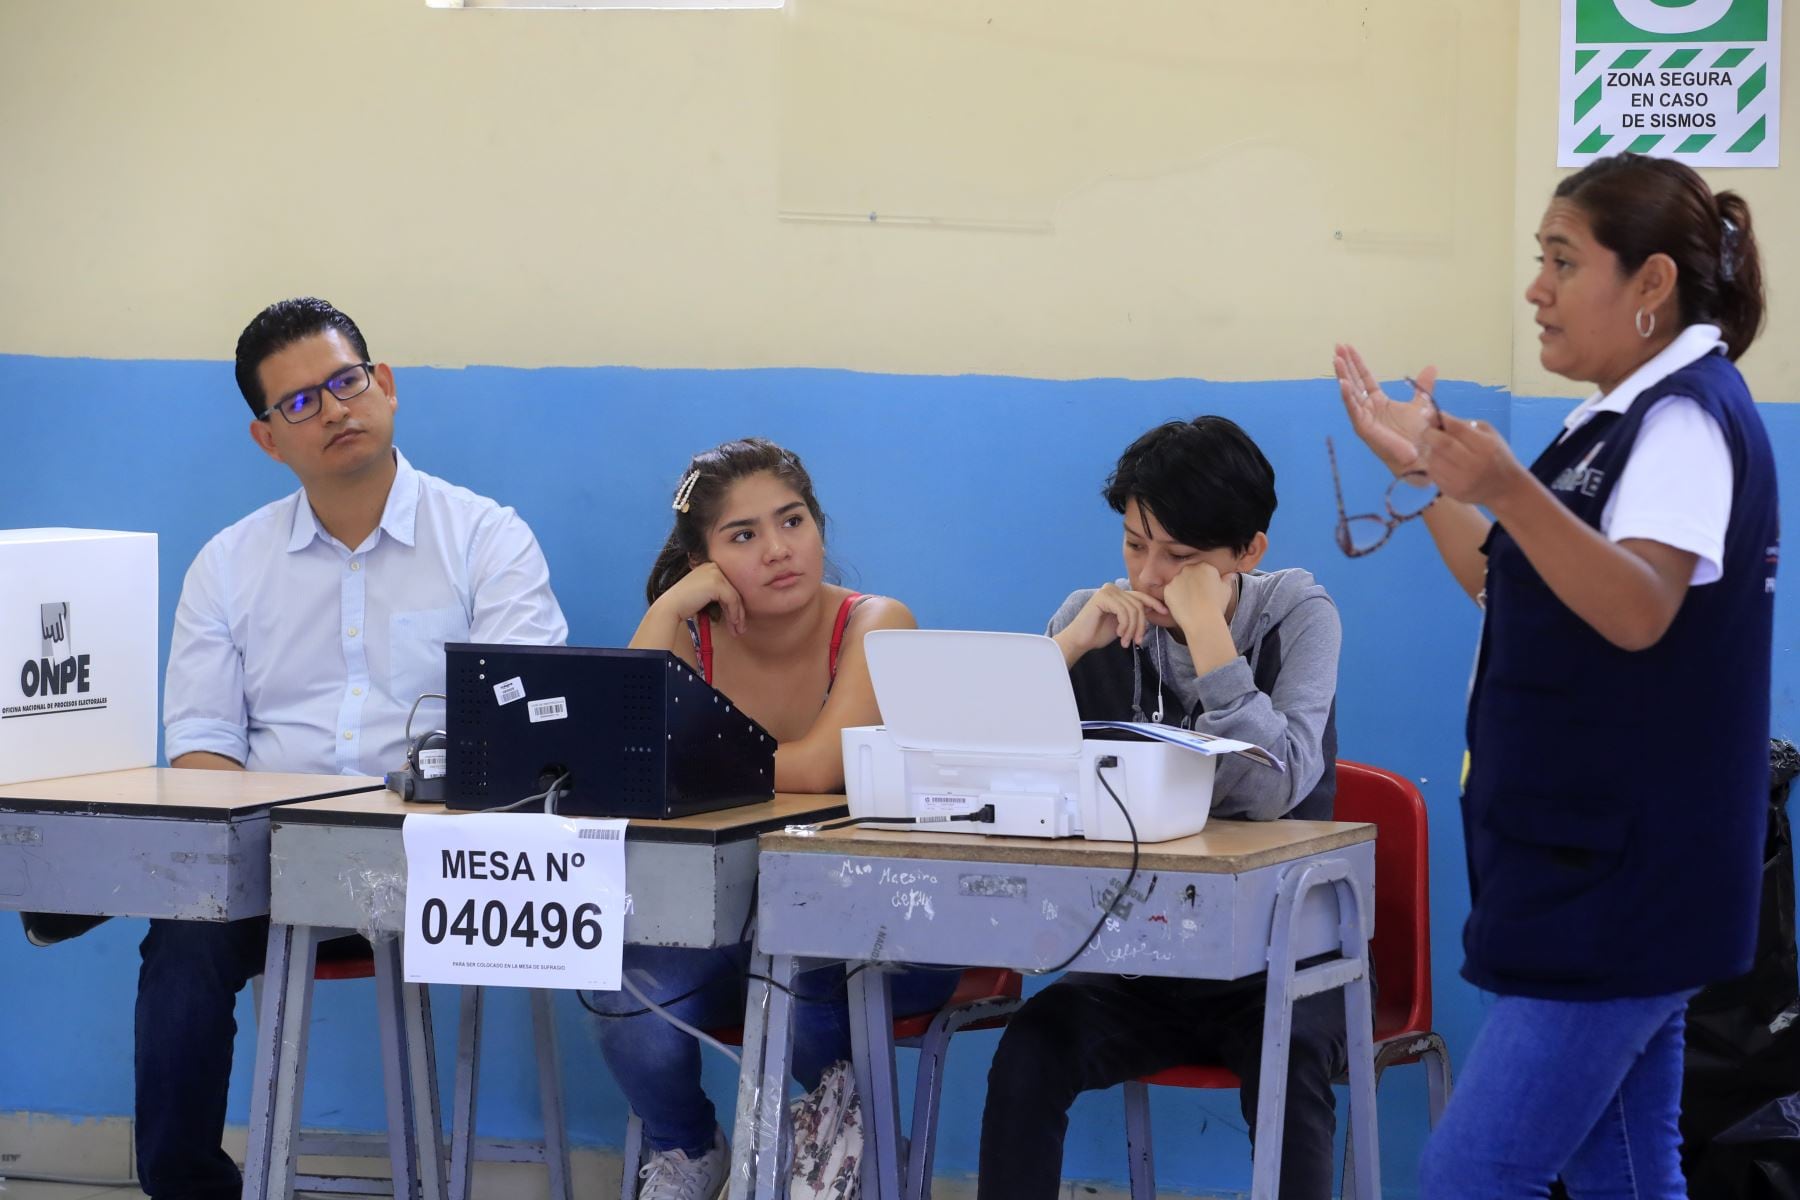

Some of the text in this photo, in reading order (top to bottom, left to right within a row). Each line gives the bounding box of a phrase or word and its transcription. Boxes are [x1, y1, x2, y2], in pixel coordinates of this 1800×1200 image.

[1606, 71, 1733, 87] ZONA SEGURA
[1631, 92, 1708, 107] EN CASO
[1622, 113, 1716, 128] DE SISMOS
[21, 654, 91, 698] ONPE
[2, 706, 21, 714] OFICINA
[22, 703, 46, 711] NACIONAL
[54, 700, 78, 708] PROCESOS
[78, 697, 108, 706] ELECTORALES
[441, 850, 536, 882] MESA
[421, 898, 604, 950] 040496
